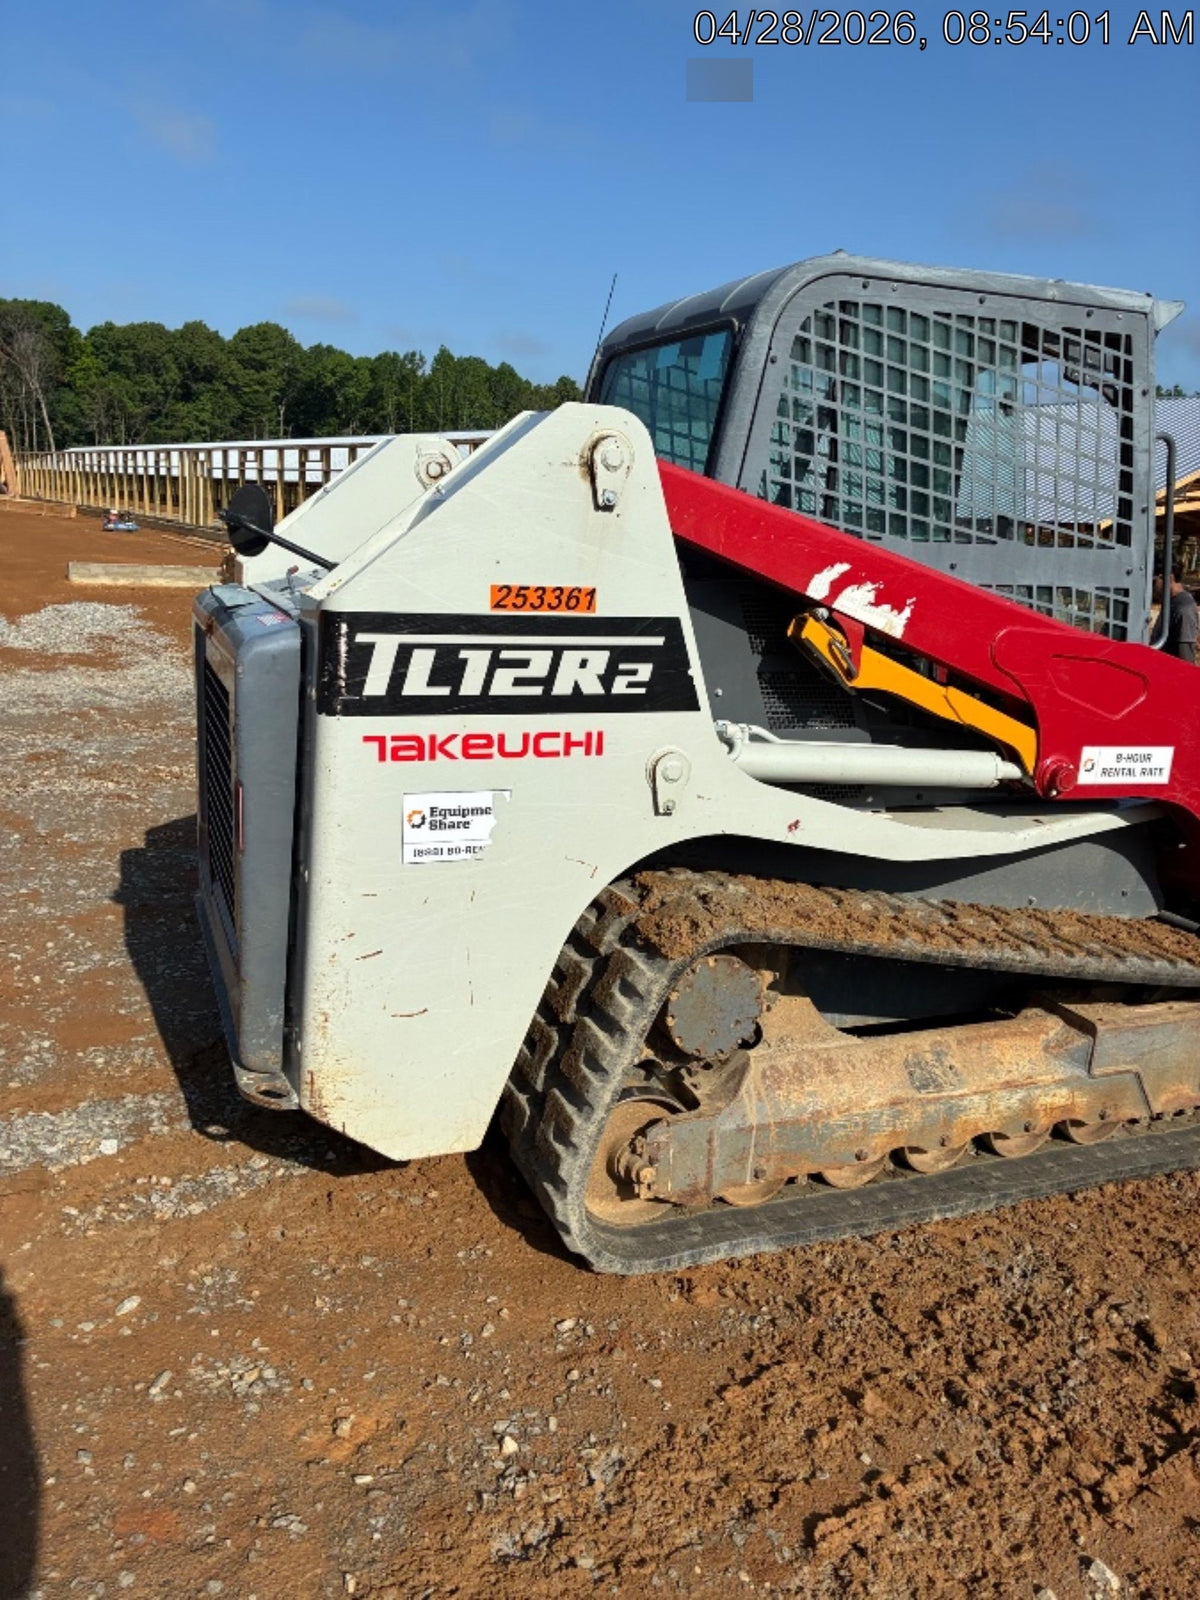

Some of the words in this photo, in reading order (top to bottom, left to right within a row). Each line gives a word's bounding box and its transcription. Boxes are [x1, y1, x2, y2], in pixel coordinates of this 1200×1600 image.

[492, 585, 596, 611] 253361
[1100, 767, 1137, 777] RENTAL
[1140, 767, 1164, 777] RATE
[429, 819, 471, 831] Share
